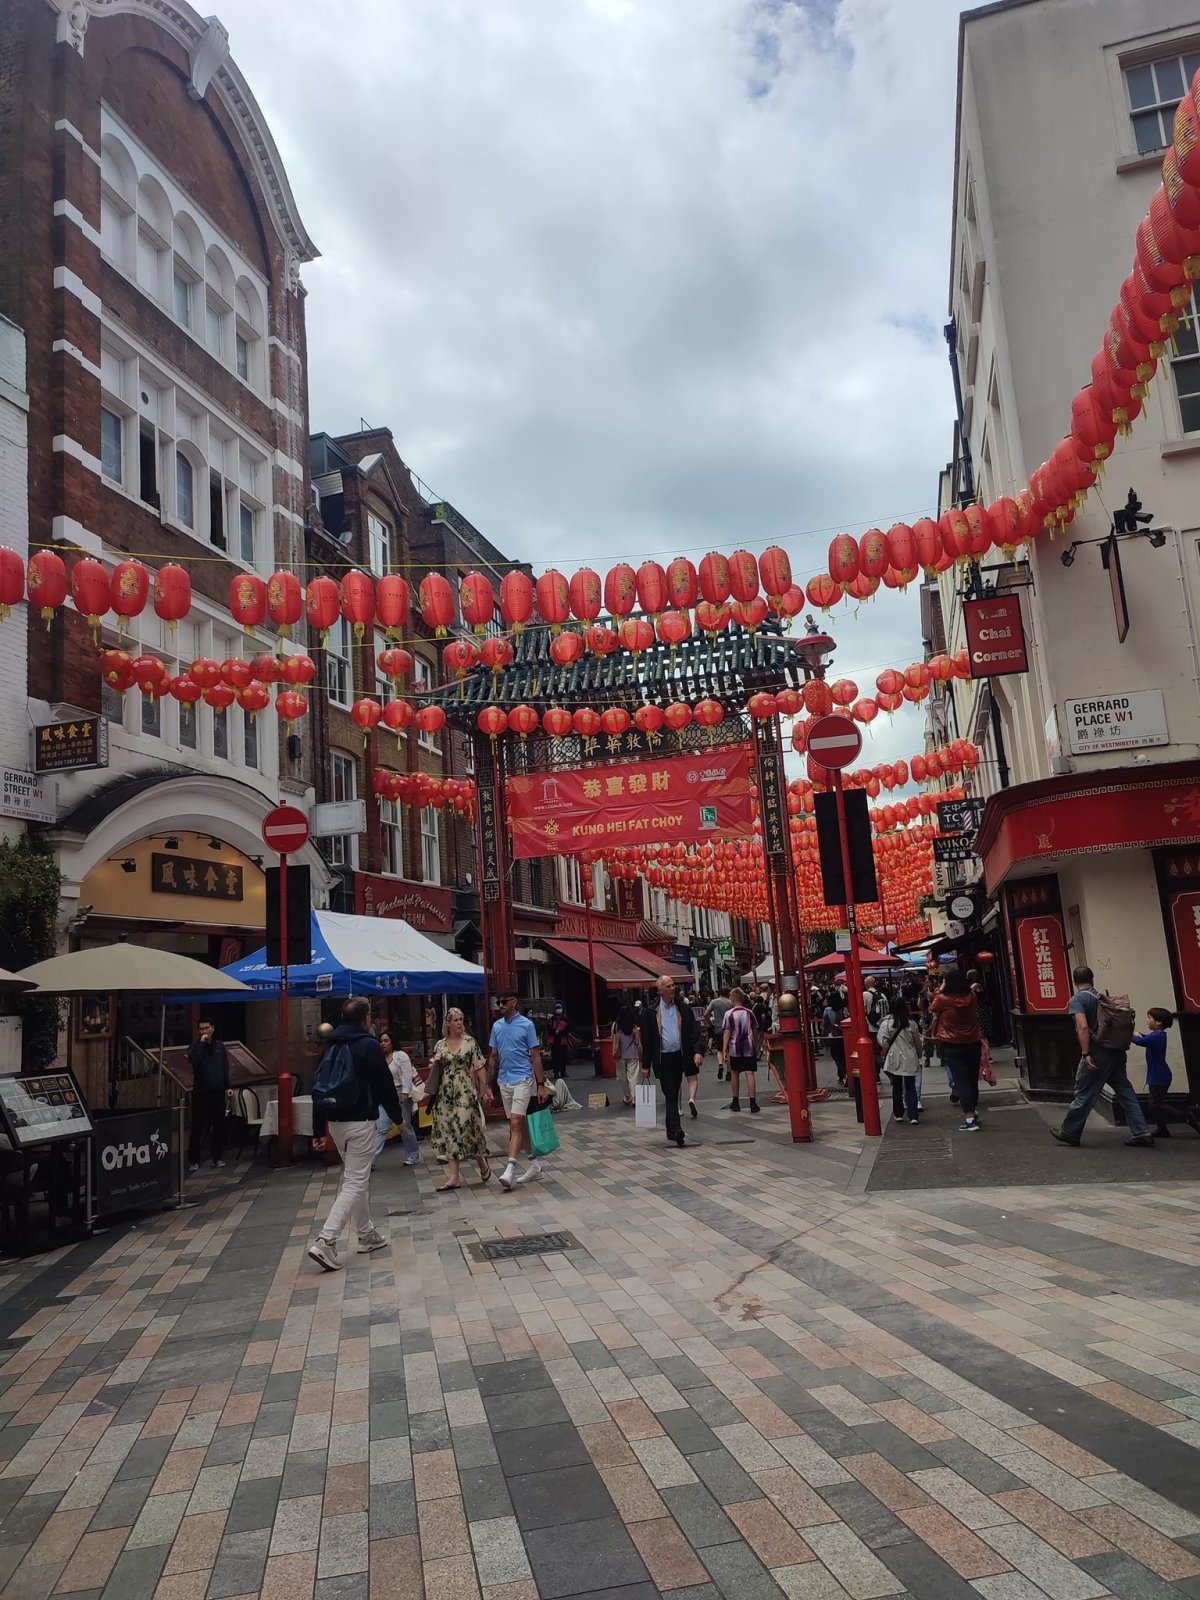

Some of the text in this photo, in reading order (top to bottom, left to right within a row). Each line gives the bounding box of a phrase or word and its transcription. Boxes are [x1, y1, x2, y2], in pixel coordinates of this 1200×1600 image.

[979, 626, 1012, 641] Chai
[973, 647, 1022, 663] Corner
[1073, 698, 1130, 714] GERRARD
[1075, 710, 1133, 727] PLACE W1
[1101, 740, 1139, 749] WESTMINSTER
[4, 771, 38, 787] GERRARD
[582, 771, 671, 799] 恭喜發財
[3, 783, 43, 799] STREET W1
[572, 823, 604, 837] KUNG
[607, 821, 627, 833] HEI
[629, 819, 649, 831] FAT
[652, 815, 683, 828] CHOY
[937, 837, 969, 850] MIKO
[376, 893, 414, 917] Wonderful
[599, 922, 635, 941] SUPERMARKET
[1032, 928, 1057, 998] 红光满面
[101, 1142, 150, 1170] Oita
